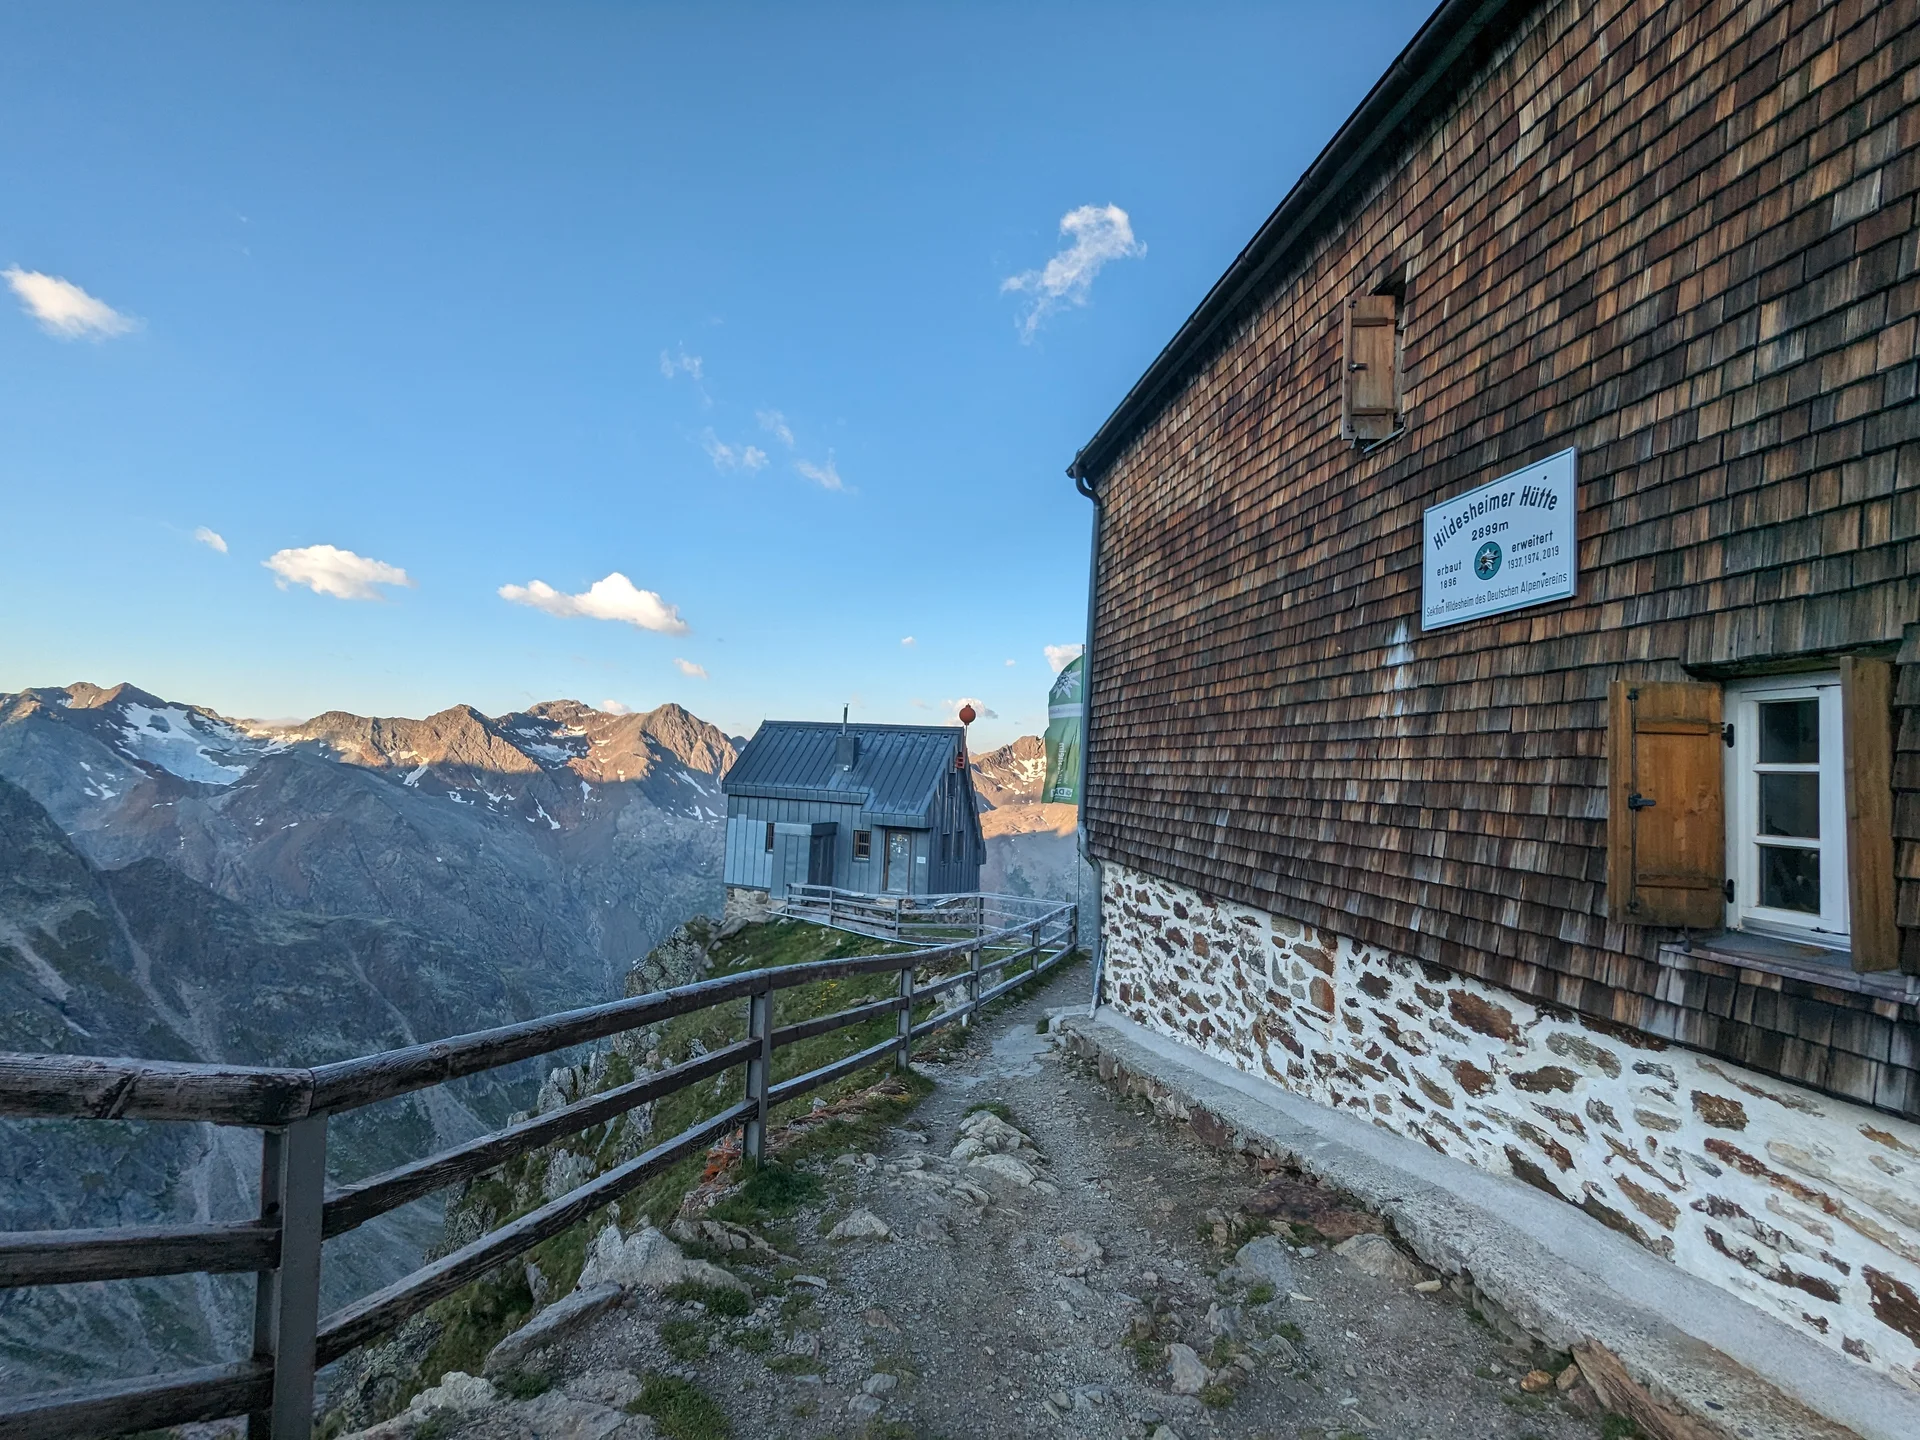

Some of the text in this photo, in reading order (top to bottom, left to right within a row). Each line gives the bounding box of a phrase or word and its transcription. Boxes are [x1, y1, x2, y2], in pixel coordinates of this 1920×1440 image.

[1433, 485, 1558, 551] Hildesheimer Hütte
[1471, 521, 1509, 541] 2899m
[1511, 530, 1553, 553] erweitert
[1436, 560, 1462, 577] erbaut
[1426, 572, 1568, 617] Sektion Hildesheim des Deutschen Alpenvereins
